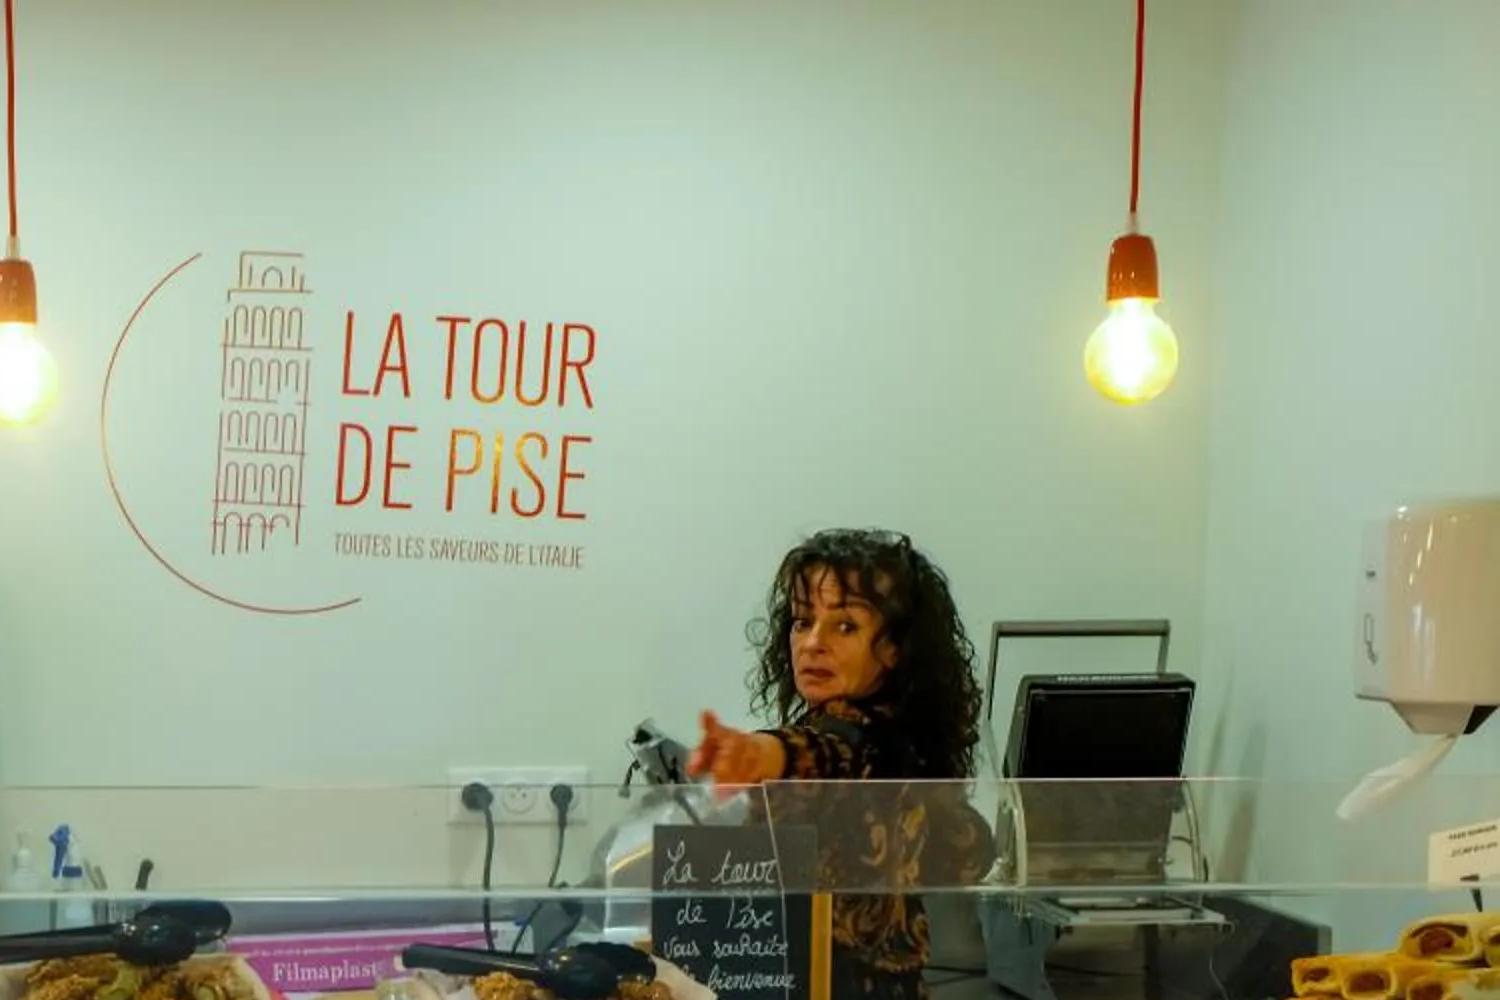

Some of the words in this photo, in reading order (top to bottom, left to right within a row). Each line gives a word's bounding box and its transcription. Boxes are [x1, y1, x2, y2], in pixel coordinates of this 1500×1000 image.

[342, 310, 410, 399] LA
[435, 315, 596, 409] TOUR
[335, 422, 418, 509] DE
[445, 427, 592, 519] PISE
[334, 533, 391, 557] TOUTES
[395, 536, 425, 560] LES
[428, 537, 500, 564] SAVEURS
[503, 543, 526, 566] DE
[528, 545, 586, 569] L'ITALIE
[661, 840, 699, 885] La
[676, 897, 707, 925] de
[272, 957, 378, 984] Filmaplast
